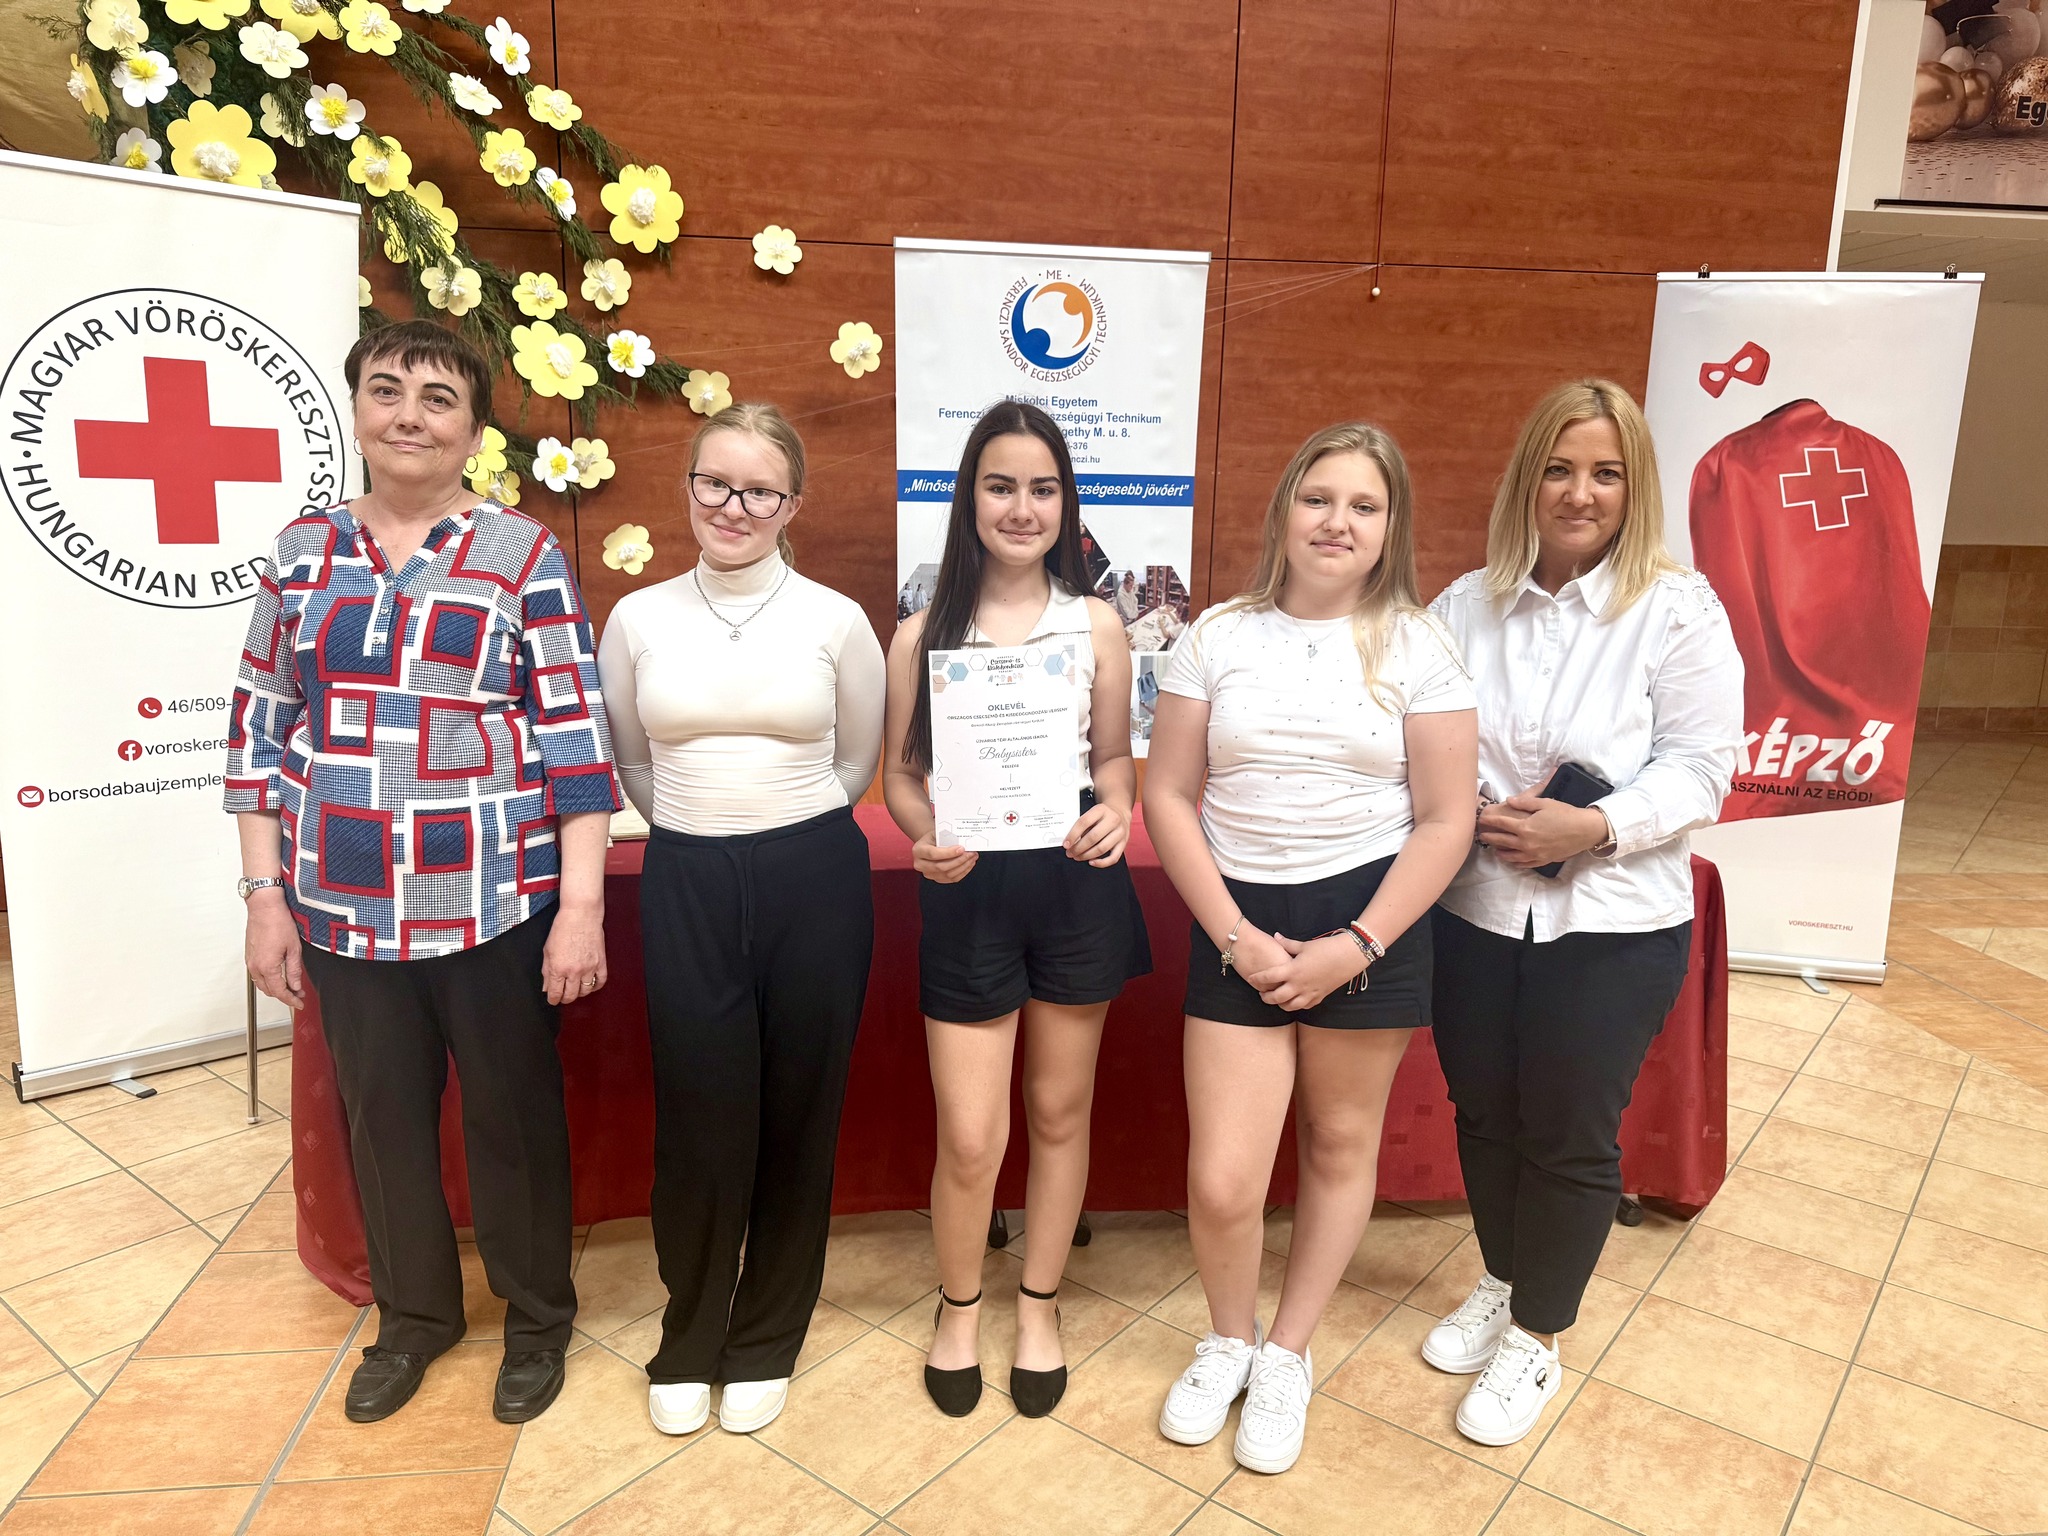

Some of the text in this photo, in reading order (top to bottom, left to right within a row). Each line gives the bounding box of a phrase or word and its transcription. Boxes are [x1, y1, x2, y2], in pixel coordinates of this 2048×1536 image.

[2016, 96, 2048, 126] Eg
[1046, 270, 1062, 280] ME
[999, 277, 1107, 382] FERENCZI SÁNDOR EGÉSZSÉGÜGYI TECHNIKUM
[11, 300, 334, 461] MAGYAR VÖRÖSKERESZT
[1051, 396, 1098, 409] Egyetem
[1050, 411, 1103, 424] szségügyi
[1106, 412, 1162, 424] Technikum
[1061, 427, 1131, 439] gethy M. u. 8.
[1070, 455, 1101, 464] nczi.hu
[1075, 482, 1143, 498] szségesebb
[13, 463, 196, 598] HUNGARIAN
[168, 696, 233, 714] 46/509-
[988, 701, 1026, 711] OKLEVÉL
[145, 737, 228, 756] voroskere
[979, 746, 1037, 762] Babysisters
[1730, 780, 1873, 803] ASZNÁLNI AZ ERŐD!
[1788, 919, 1854, 931] VOROSKERESZT.HU
